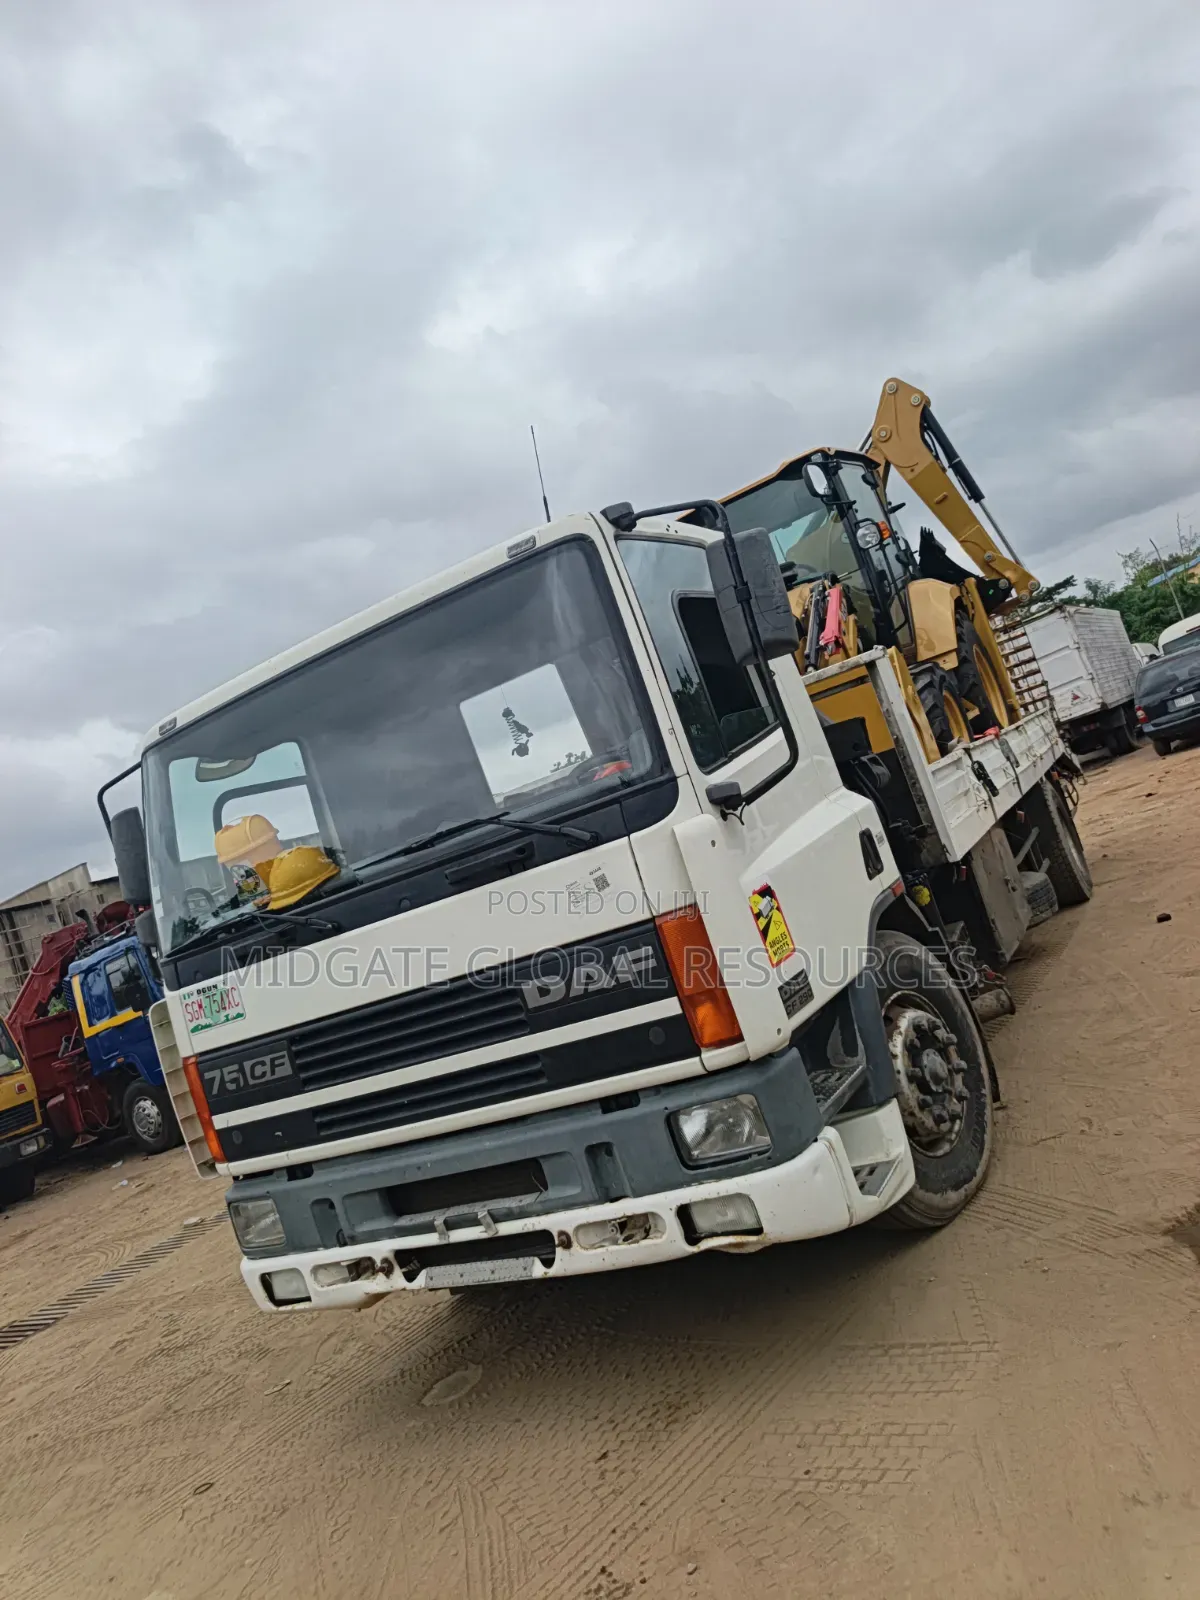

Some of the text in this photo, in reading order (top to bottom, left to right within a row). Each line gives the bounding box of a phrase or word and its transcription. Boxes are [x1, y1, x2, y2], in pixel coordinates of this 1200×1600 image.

[768, 931, 788, 949] ANGLES
[773, 941, 790, 957] MORTS
[521, 946, 657, 1009] DAF
[196, 984, 218, 995] OGUN
[785, 1000, 798, 1016] CF
